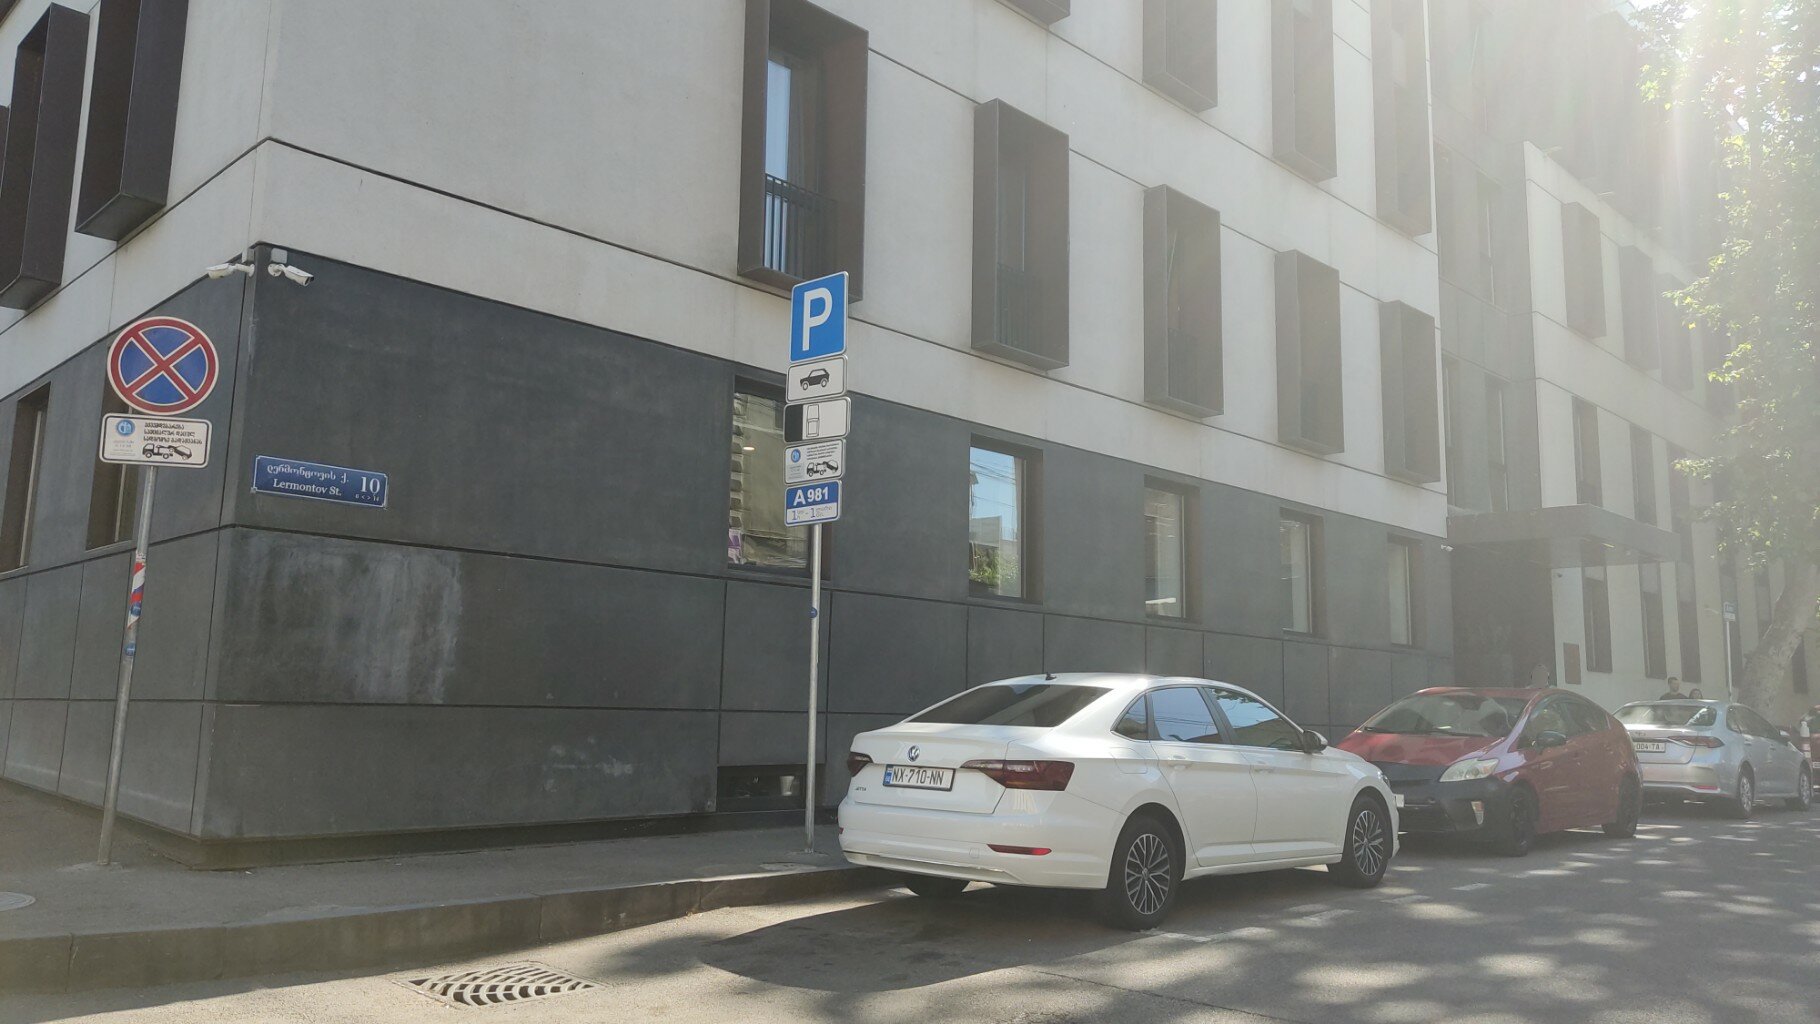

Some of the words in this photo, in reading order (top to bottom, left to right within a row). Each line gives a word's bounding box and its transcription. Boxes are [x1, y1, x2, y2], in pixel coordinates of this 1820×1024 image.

[802, 287, 833, 351] P
[273, 478, 328, 494] Lermontov
[329, 485, 342, 497] St.
[360, 476, 380, 495] 10
[893, 768, 944, 786] NX-710-NN
